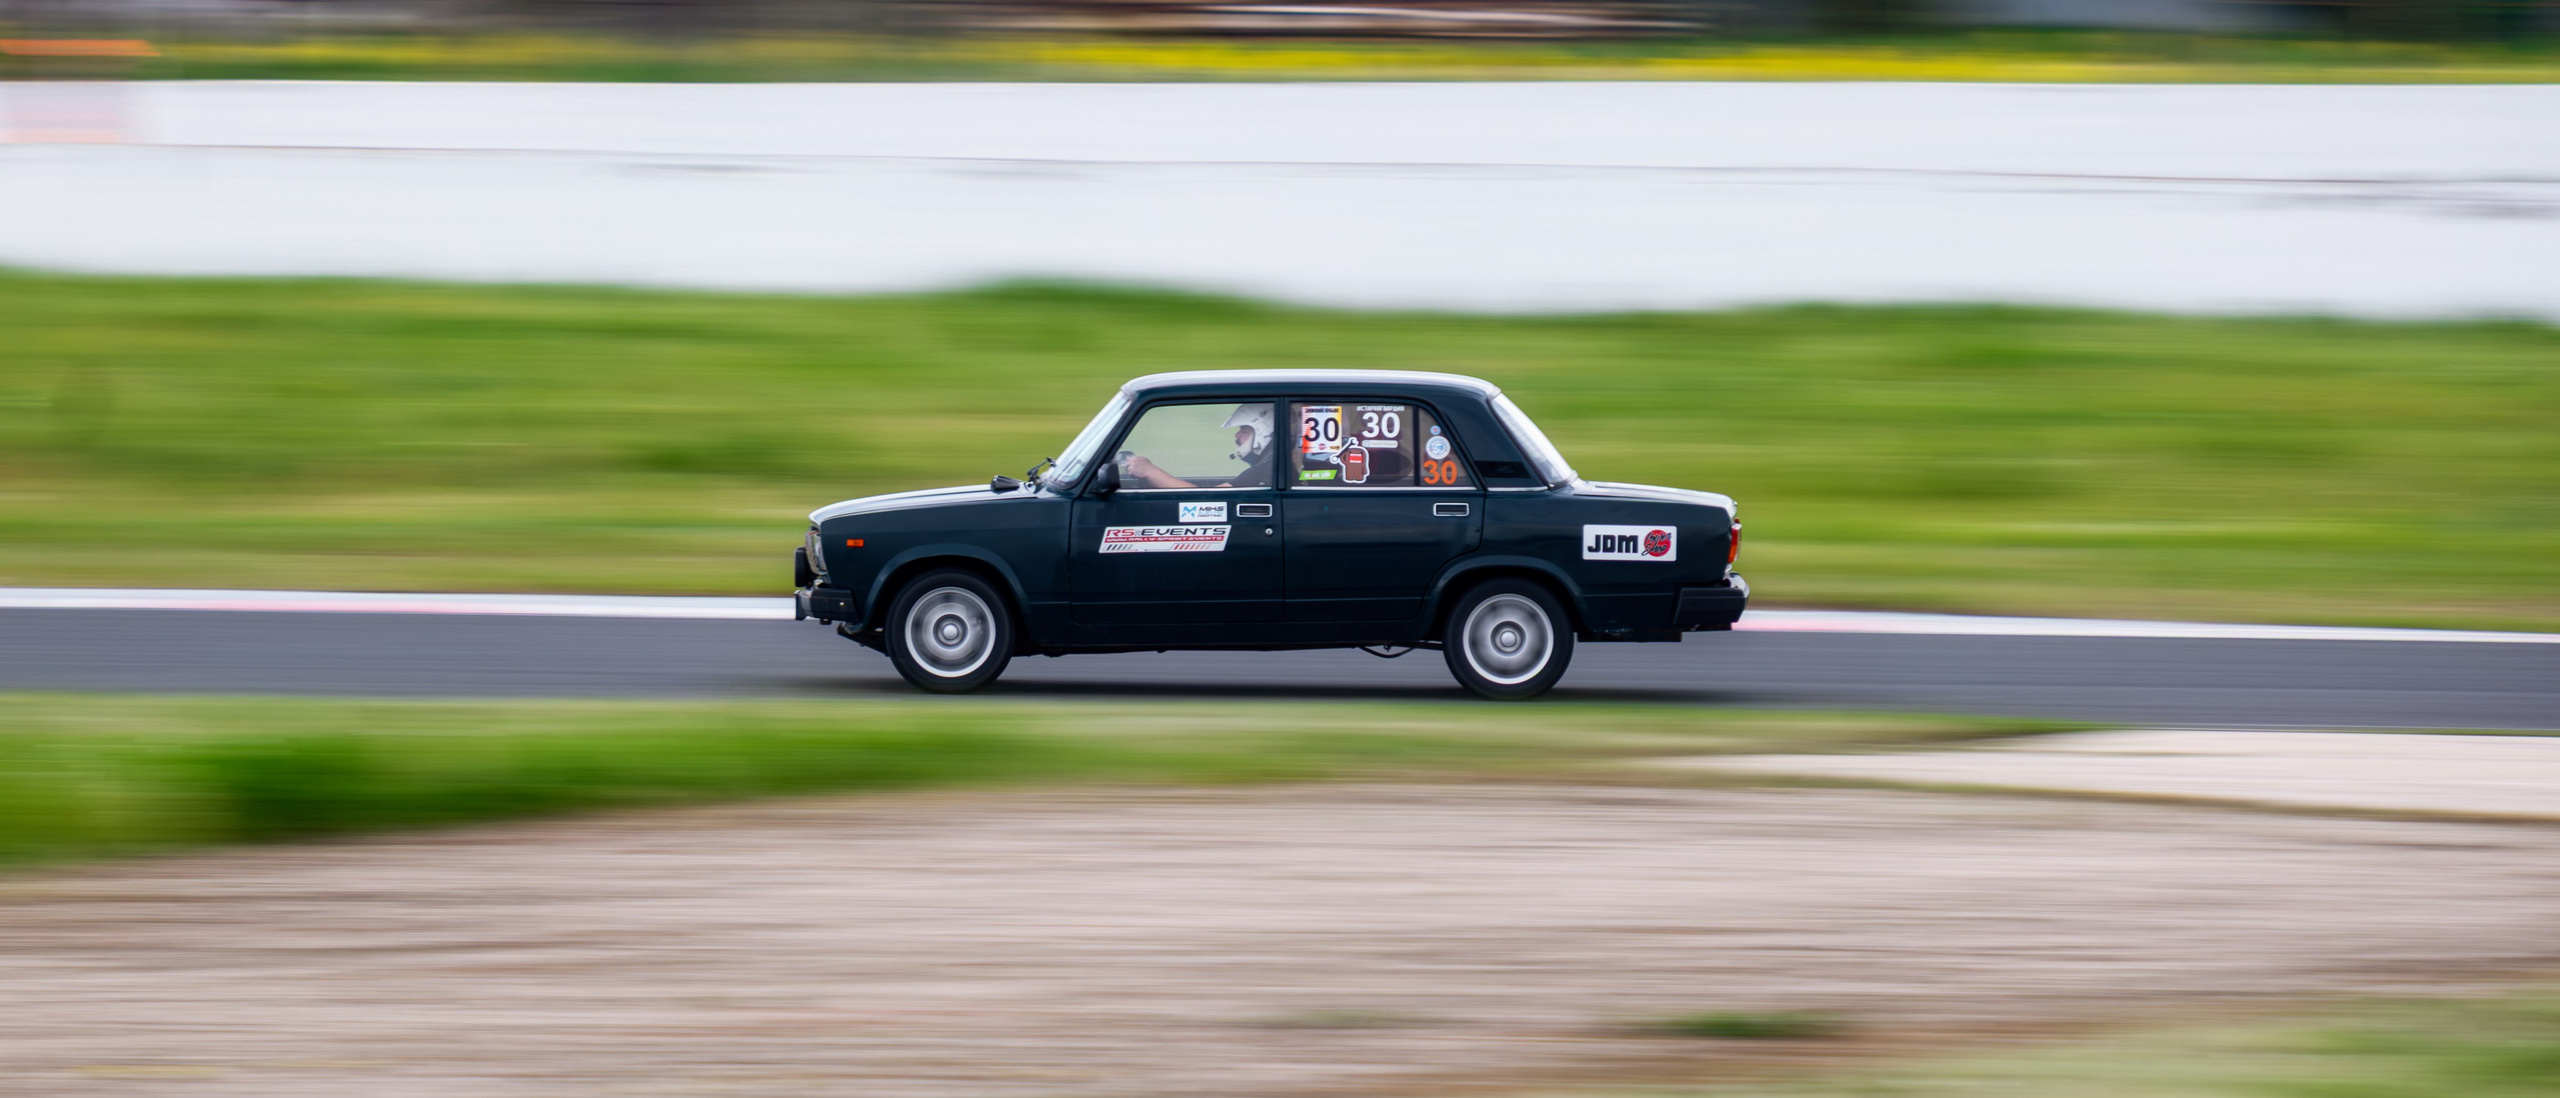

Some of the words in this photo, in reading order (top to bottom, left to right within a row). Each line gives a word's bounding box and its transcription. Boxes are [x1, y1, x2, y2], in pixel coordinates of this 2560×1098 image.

[1304, 417, 1339, 442] 30
[1361, 412, 1400, 438] 30
[1423, 460, 1458, 485] 30
[1587, 534, 1638, 553] JDM
